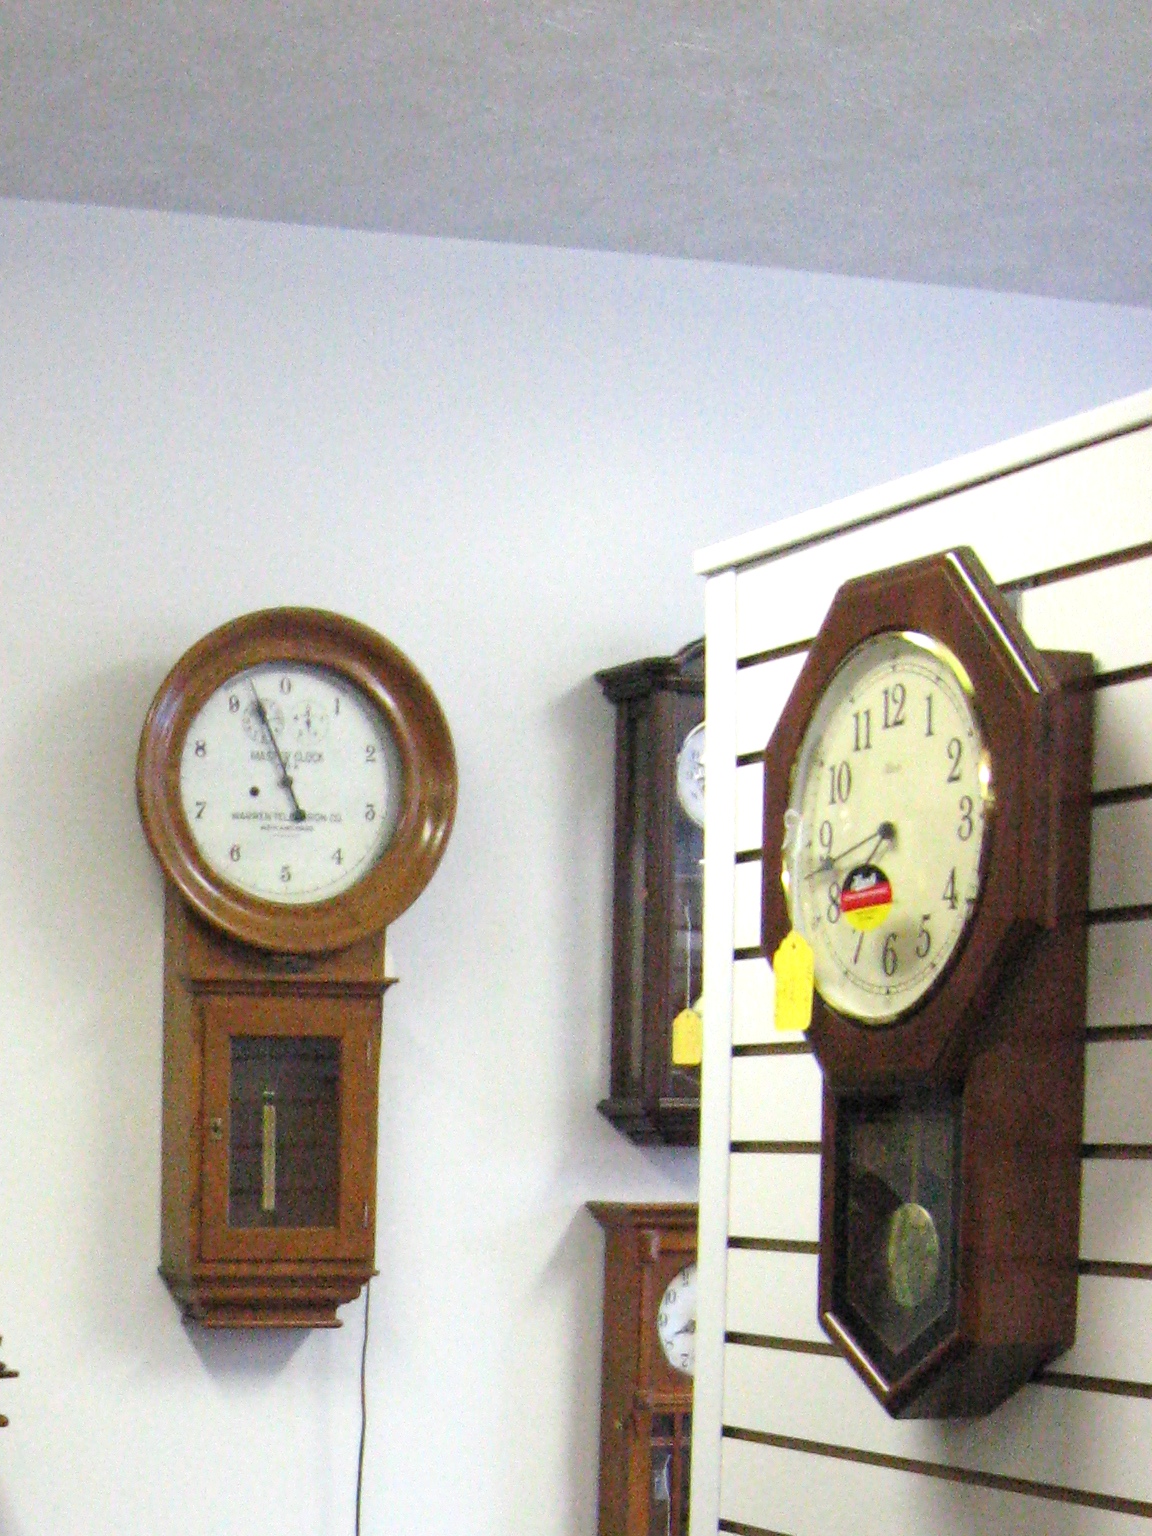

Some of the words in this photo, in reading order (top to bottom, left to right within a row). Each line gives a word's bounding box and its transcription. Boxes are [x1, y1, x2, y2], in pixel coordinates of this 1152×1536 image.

[881, 683, 906, 729] 12
[924, 693, 935, 737] 1
[852, 709, 873, 752] 11
[947, 737, 963, 784] 2
[828, 761, 852, 806] 10
[818, 820, 834, 860] 9
[957, 795, 974, 842] 3
[826, 880, 842, 925] 8
[943, 866, 959, 910] 4
[882, 932, 899, 978] 6
[915, 914, 933, 959] 5
